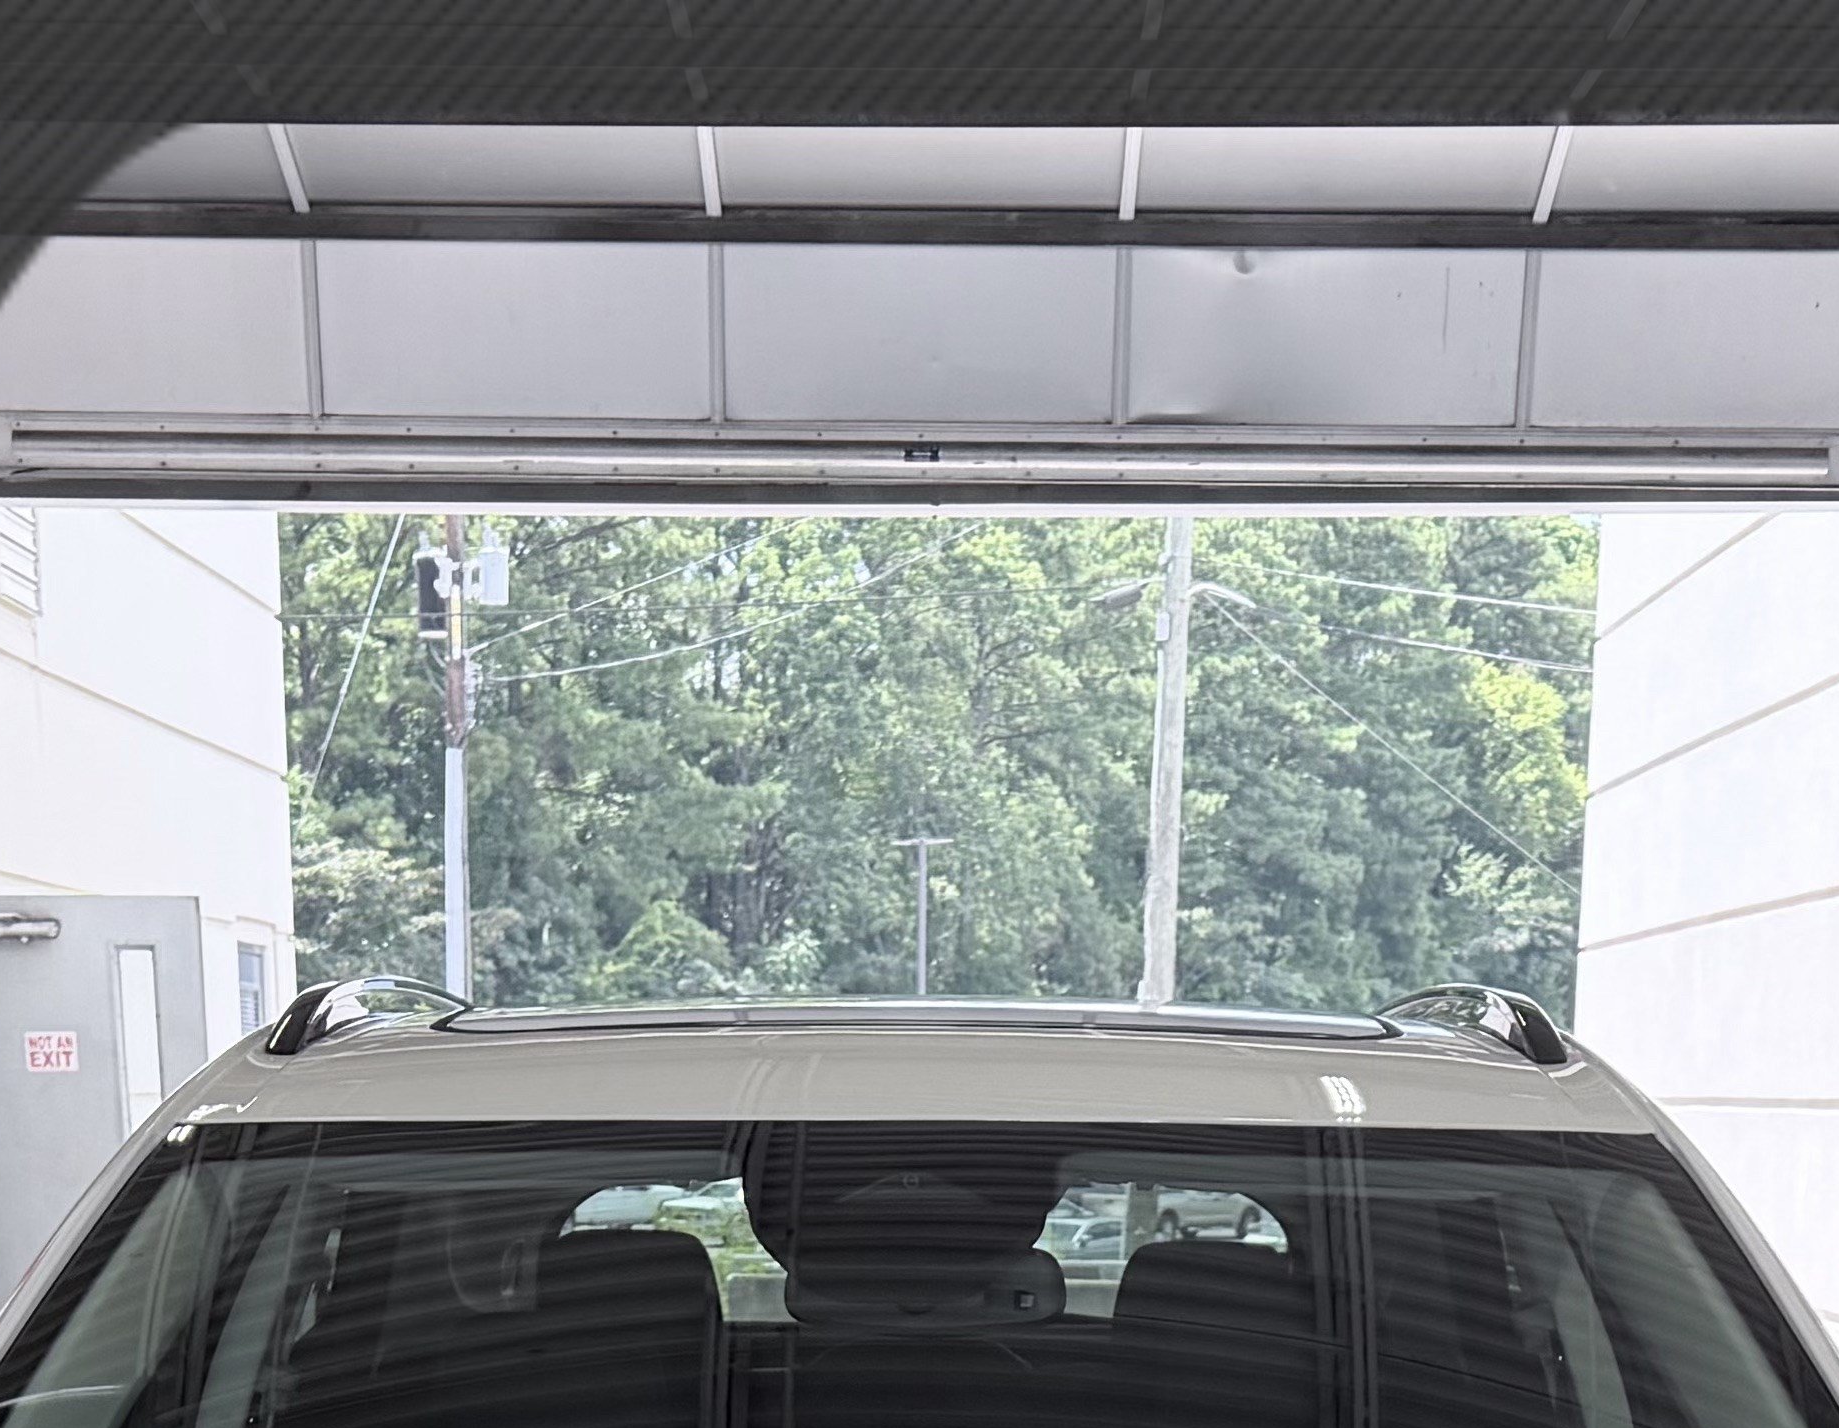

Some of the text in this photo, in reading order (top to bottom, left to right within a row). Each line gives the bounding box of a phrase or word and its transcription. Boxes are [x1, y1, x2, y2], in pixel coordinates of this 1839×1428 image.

[28, 1035, 73, 1050] NOT AN
[29, 1050, 73, 1068] EXIT
